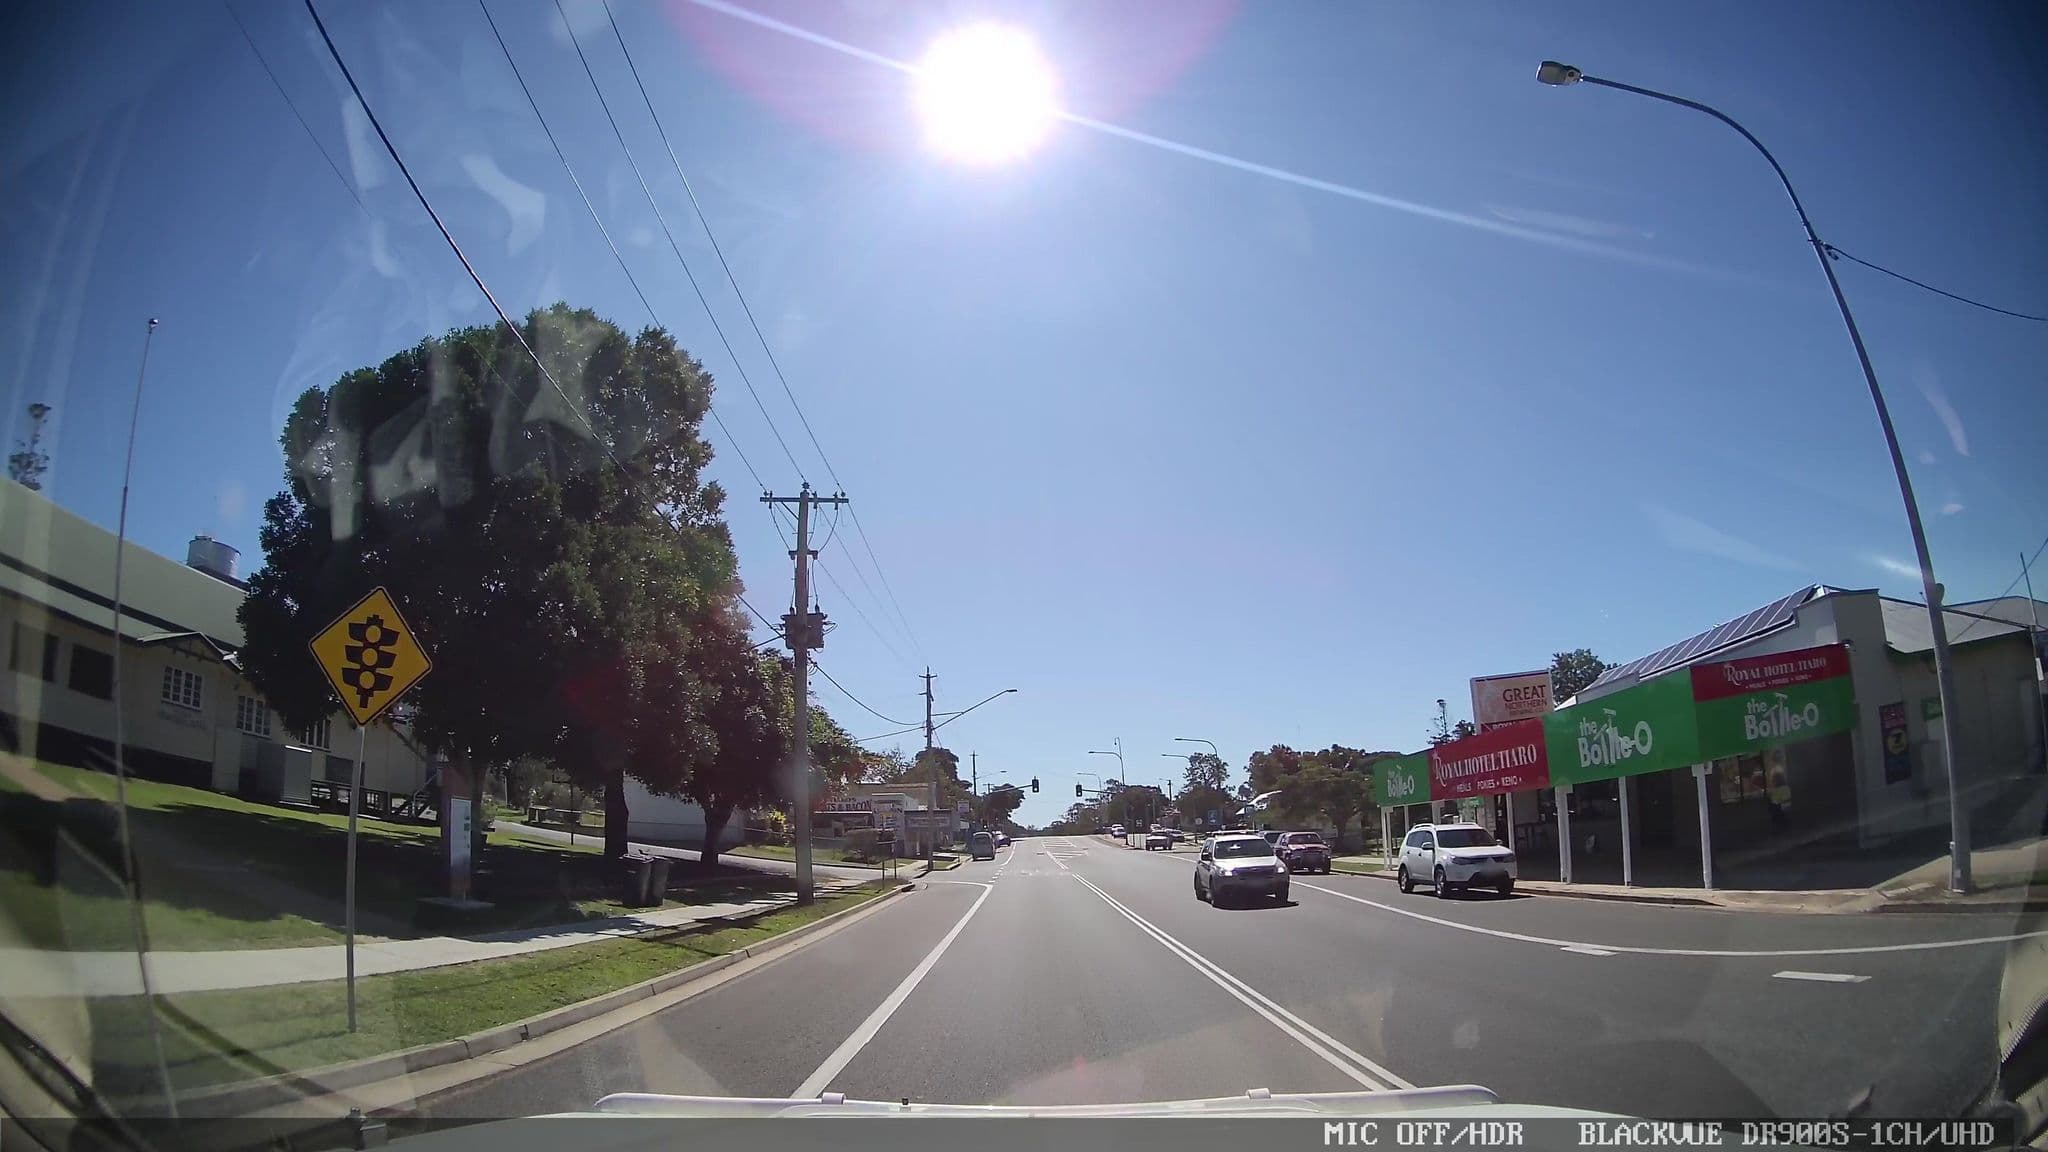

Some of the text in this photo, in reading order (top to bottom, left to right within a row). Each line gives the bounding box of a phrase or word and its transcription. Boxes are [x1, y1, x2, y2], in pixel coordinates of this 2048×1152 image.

[1502, 684, 1546, 702] GREAT
[1504, 698, 1548, 710] NORTHERN
[1746, 698, 1767, 714] the
[1579, 717, 1597, 736] the
[1498, 744, 1537, 769] TIARO
